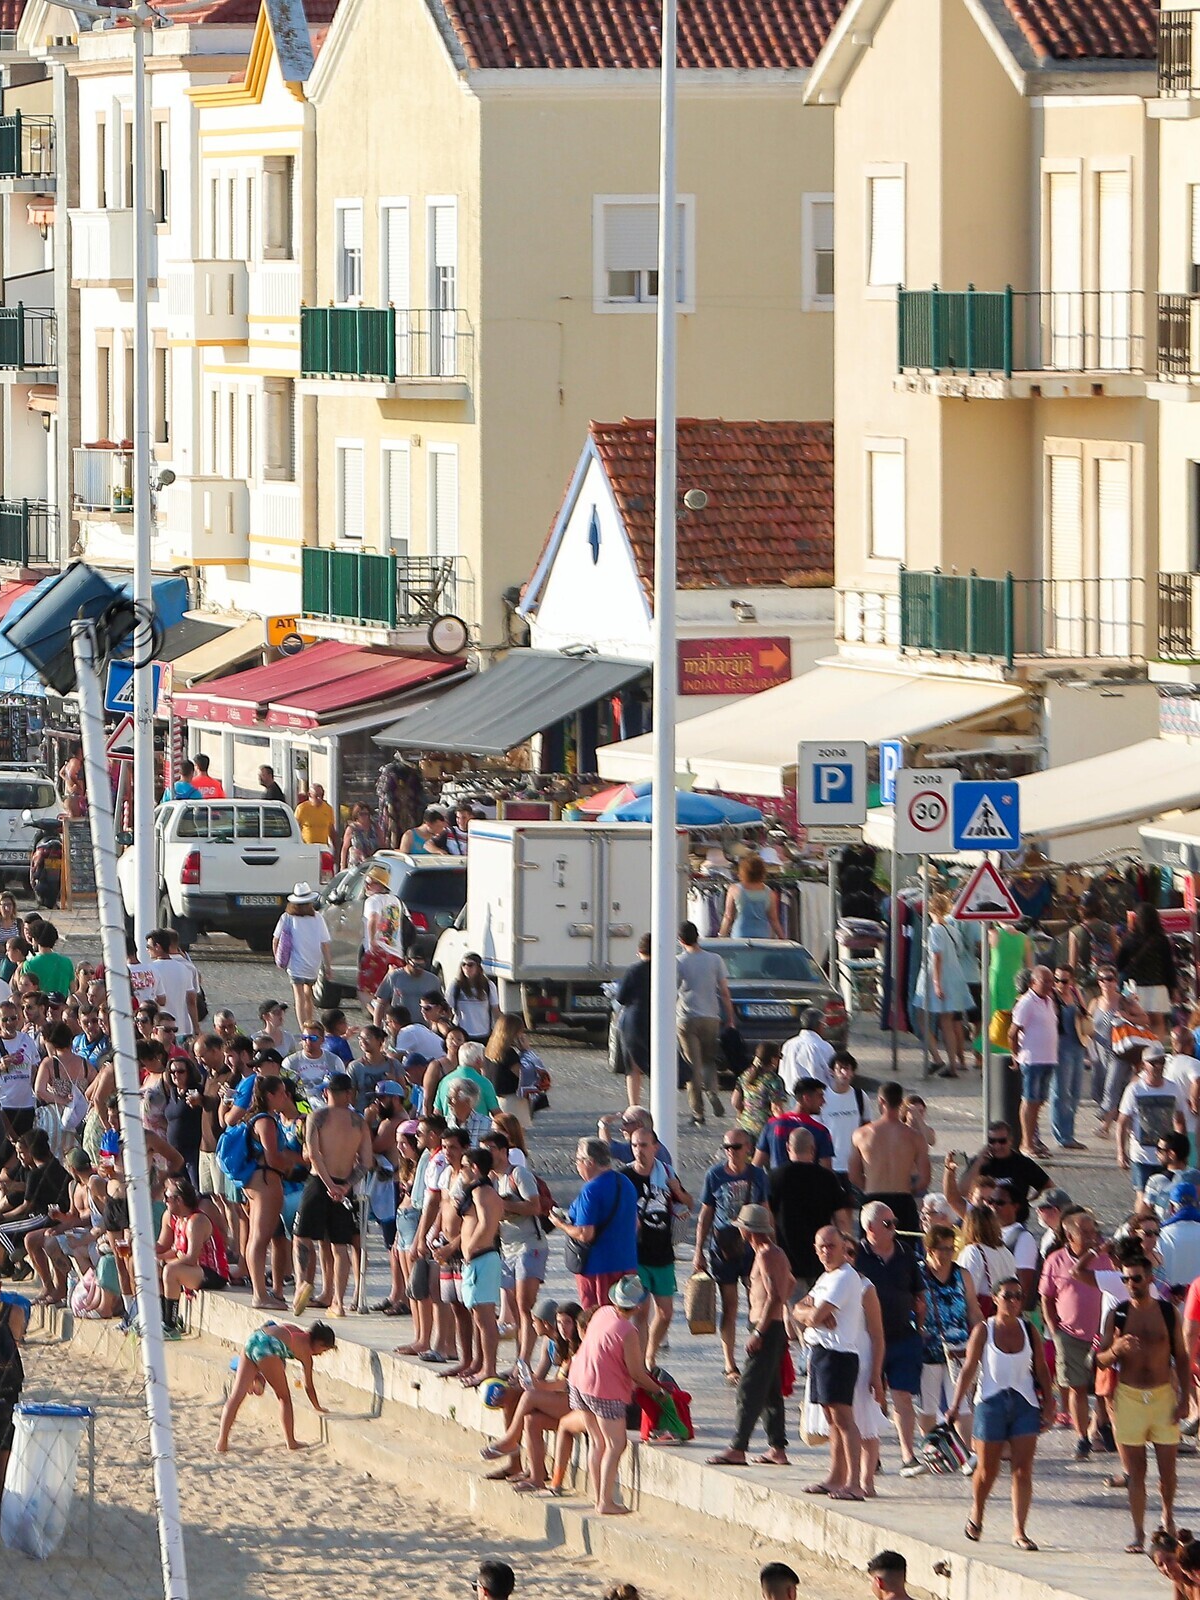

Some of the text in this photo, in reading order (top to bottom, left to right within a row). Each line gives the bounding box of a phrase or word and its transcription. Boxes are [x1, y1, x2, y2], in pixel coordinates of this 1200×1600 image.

[275, 618, 297, 629] AT
[683, 651, 754, 677] maharaja
[683, 680, 720, 691] INDIAN
[817, 748, 847, 758] zona
[884, 747, 897, 799] P
[913, 774, 943, 784] zona
[820, 766, 846, 800] P
[915, 803, 941, 820] 30
